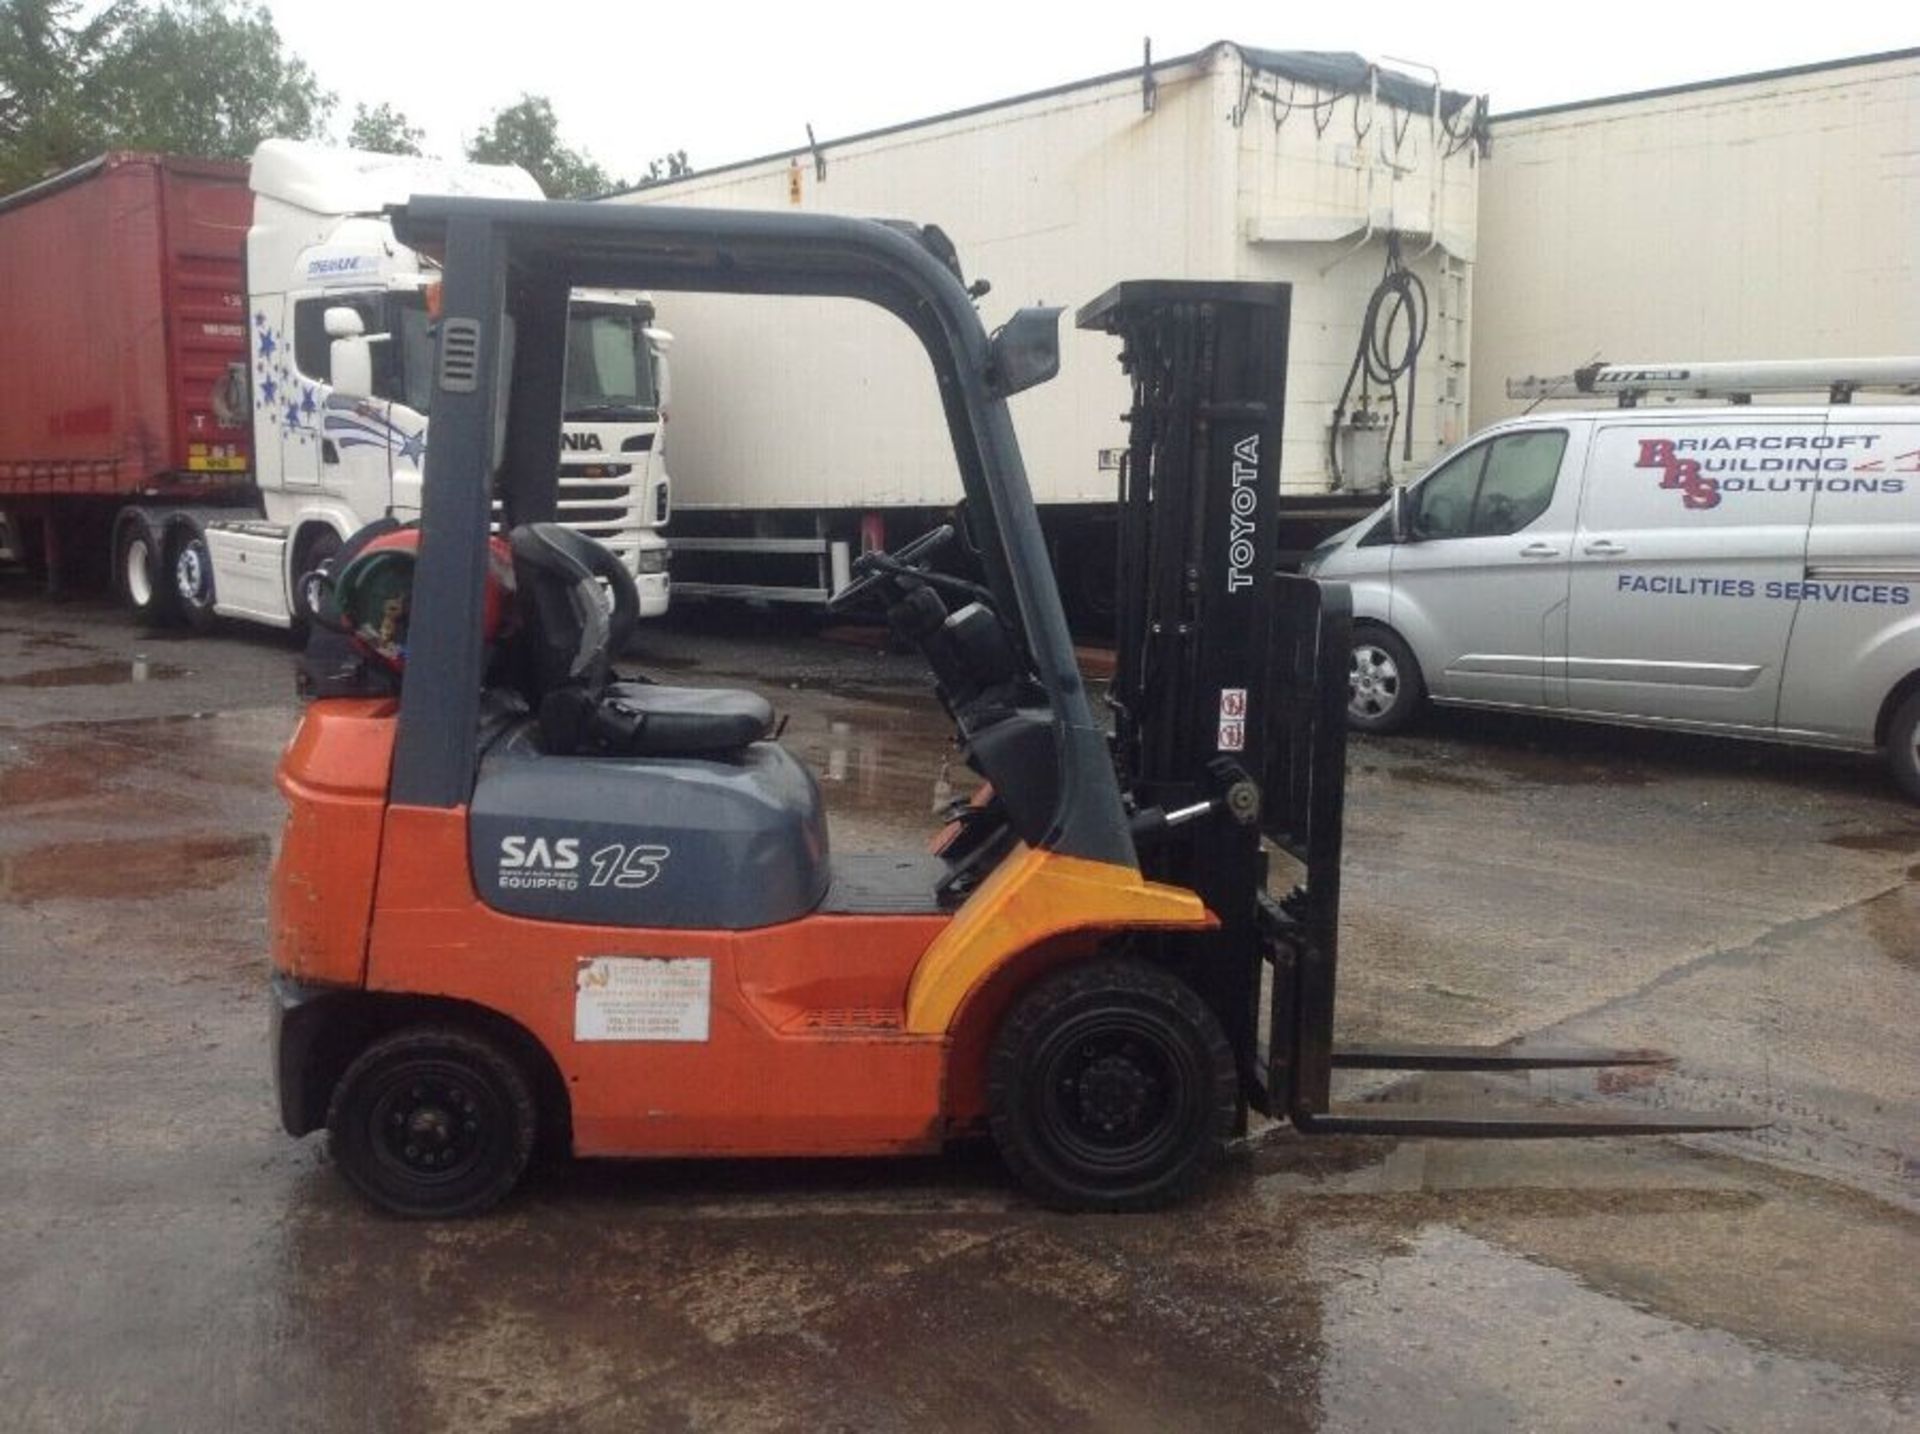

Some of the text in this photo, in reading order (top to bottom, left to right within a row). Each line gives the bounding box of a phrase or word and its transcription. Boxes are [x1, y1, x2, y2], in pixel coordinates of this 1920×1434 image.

[562, 432, 603, 451] NIA
[1635, 435, 1881, 468] BRIARCROFT
[1659, 457, 1848, 490] BUILDING
[1682, 477, 1905, 510] SOLUTIONS
[1228, 433, 1260, 594] TOYOTA
[1617, 575, 1910, 605] FACILITIES SERVICES
[499, 836, 671, 888] SAS 15
[499, 876, 578, 890] EQUIPPED
